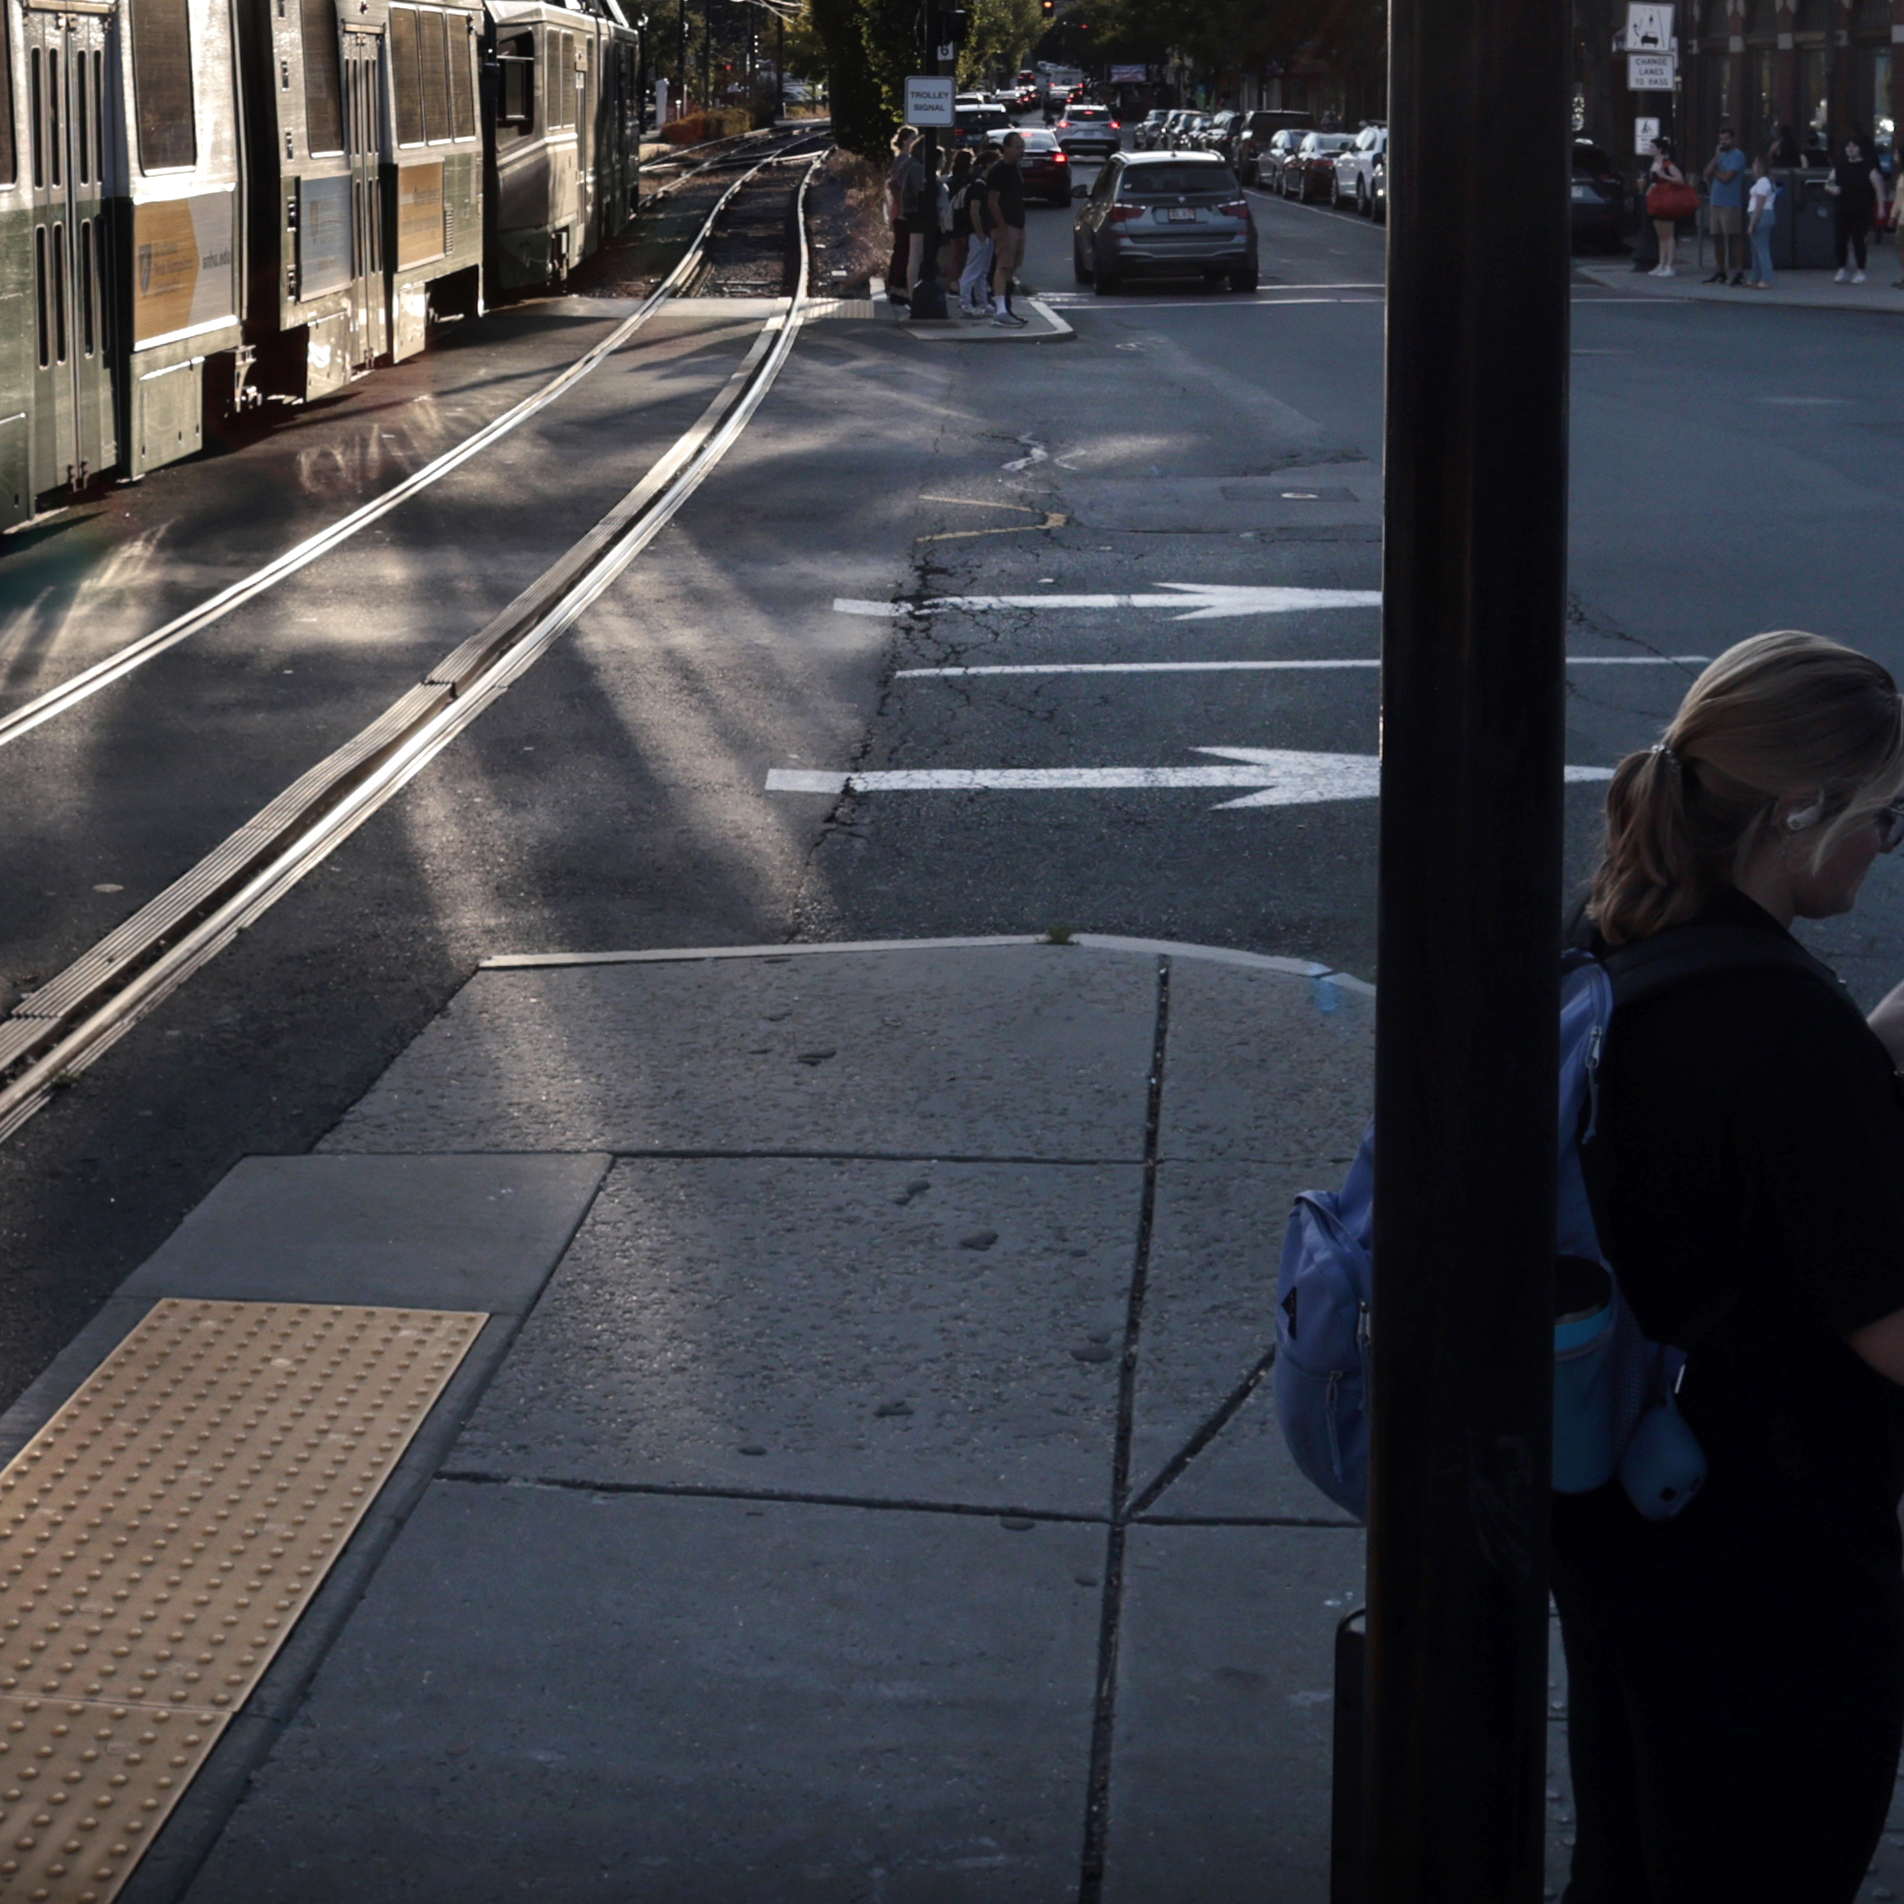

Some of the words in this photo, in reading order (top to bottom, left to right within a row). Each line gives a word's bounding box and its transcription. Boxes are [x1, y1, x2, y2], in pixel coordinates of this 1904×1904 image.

[1635, 58, 1667, 66] CHANGE
[1639, 68, 1664, 76] LANES
[1635, 77, 1645, 86] TO
[1648, 77, 1669, 86] PASS
[910, 91, 949, 99] TROLLEY
